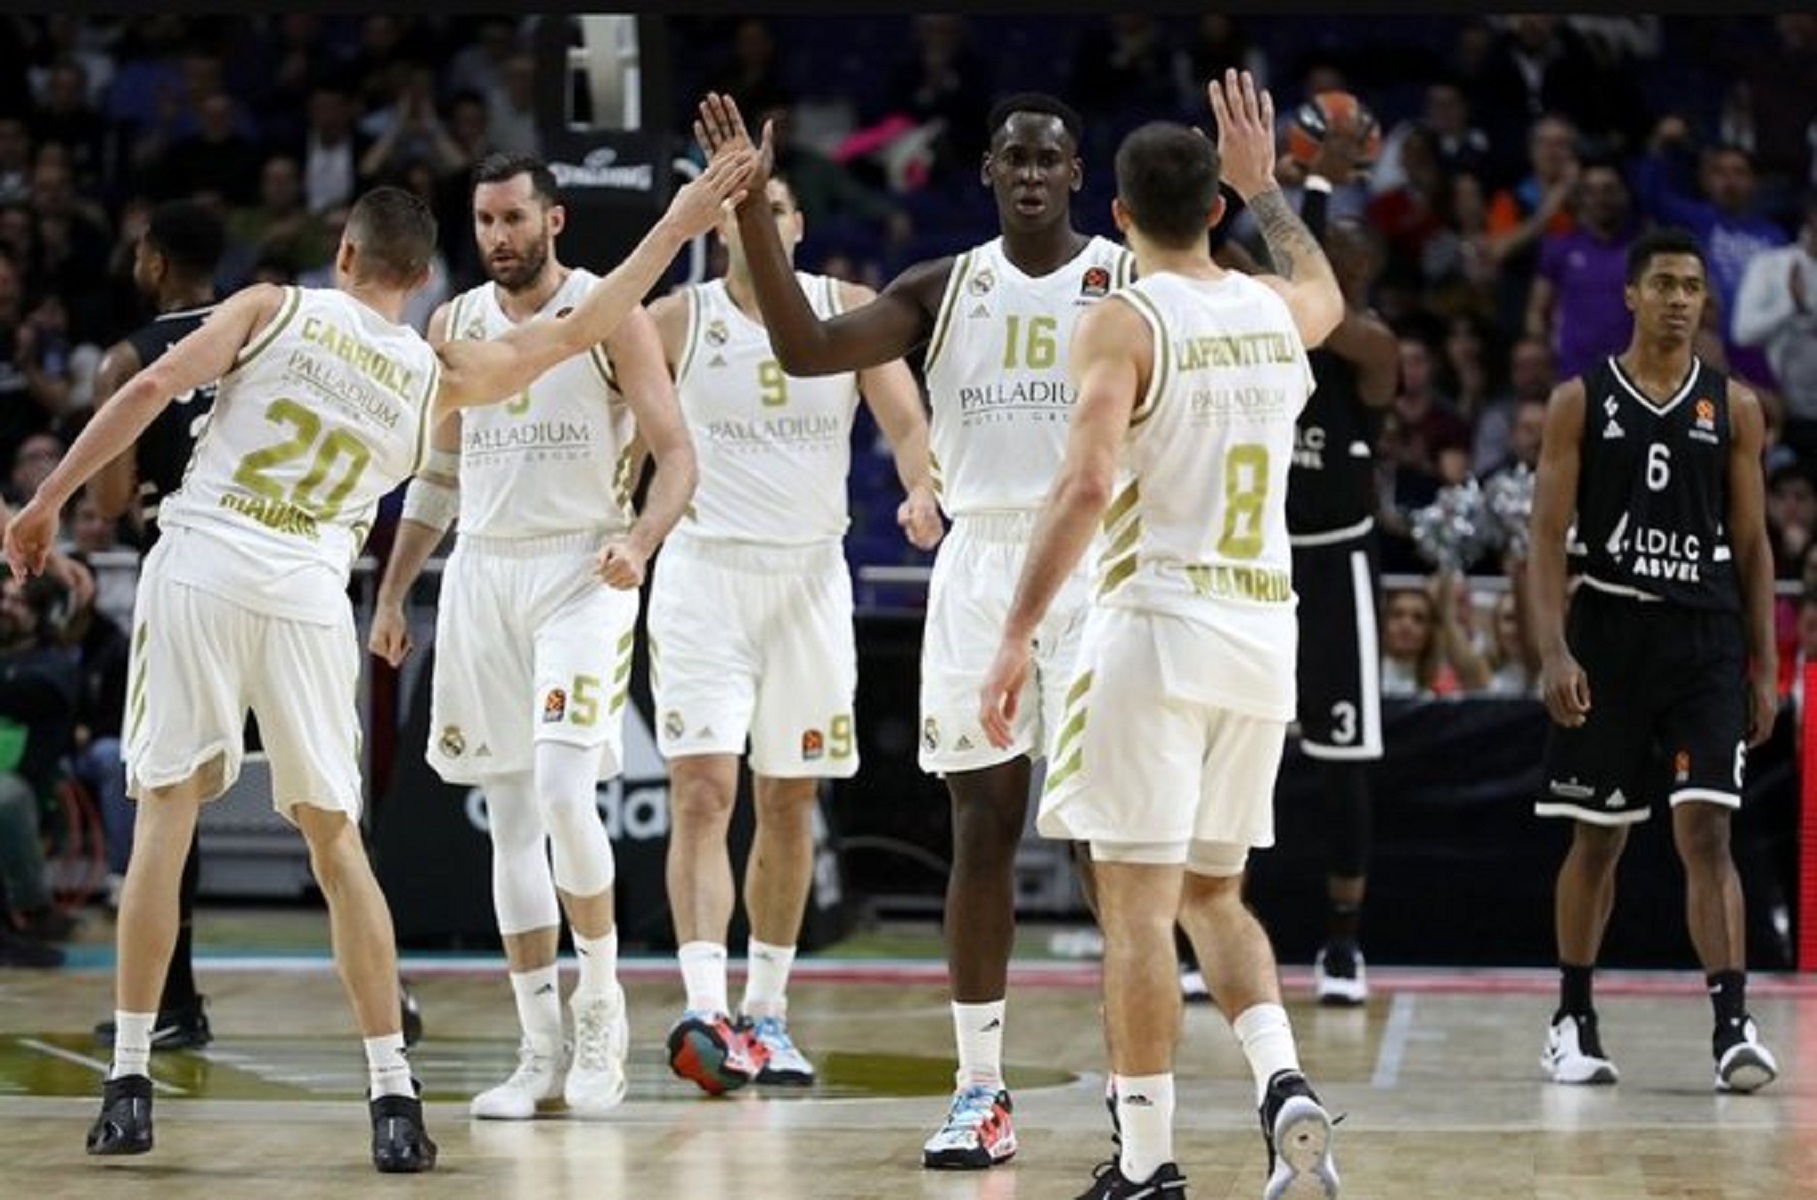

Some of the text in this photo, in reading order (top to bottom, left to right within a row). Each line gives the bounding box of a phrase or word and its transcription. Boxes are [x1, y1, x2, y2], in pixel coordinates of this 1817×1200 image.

[301, 316, 414, 401] CARROLL
[1004, 315, 1058, 370] 16
[287, 349, 400, 430] PALLADIUM
[758, 361, 788, 407] 9
[959, 380, 1080, 410] PALLADIU
[709, 413, 838, 440] PALLADIUM
[232, 397, 372, 522] 20
[1646, 442, 1671, 491] 6
[1217, 443, 1270, 560] 8
[1634, 525, 1701, 561] LDLC
[1632, 555, 1701, 583] ASVEL
[570, 675, 600, 726] 5
[1331, 701, 1357, 744] 3
[828, 714, 851, 758] 9
